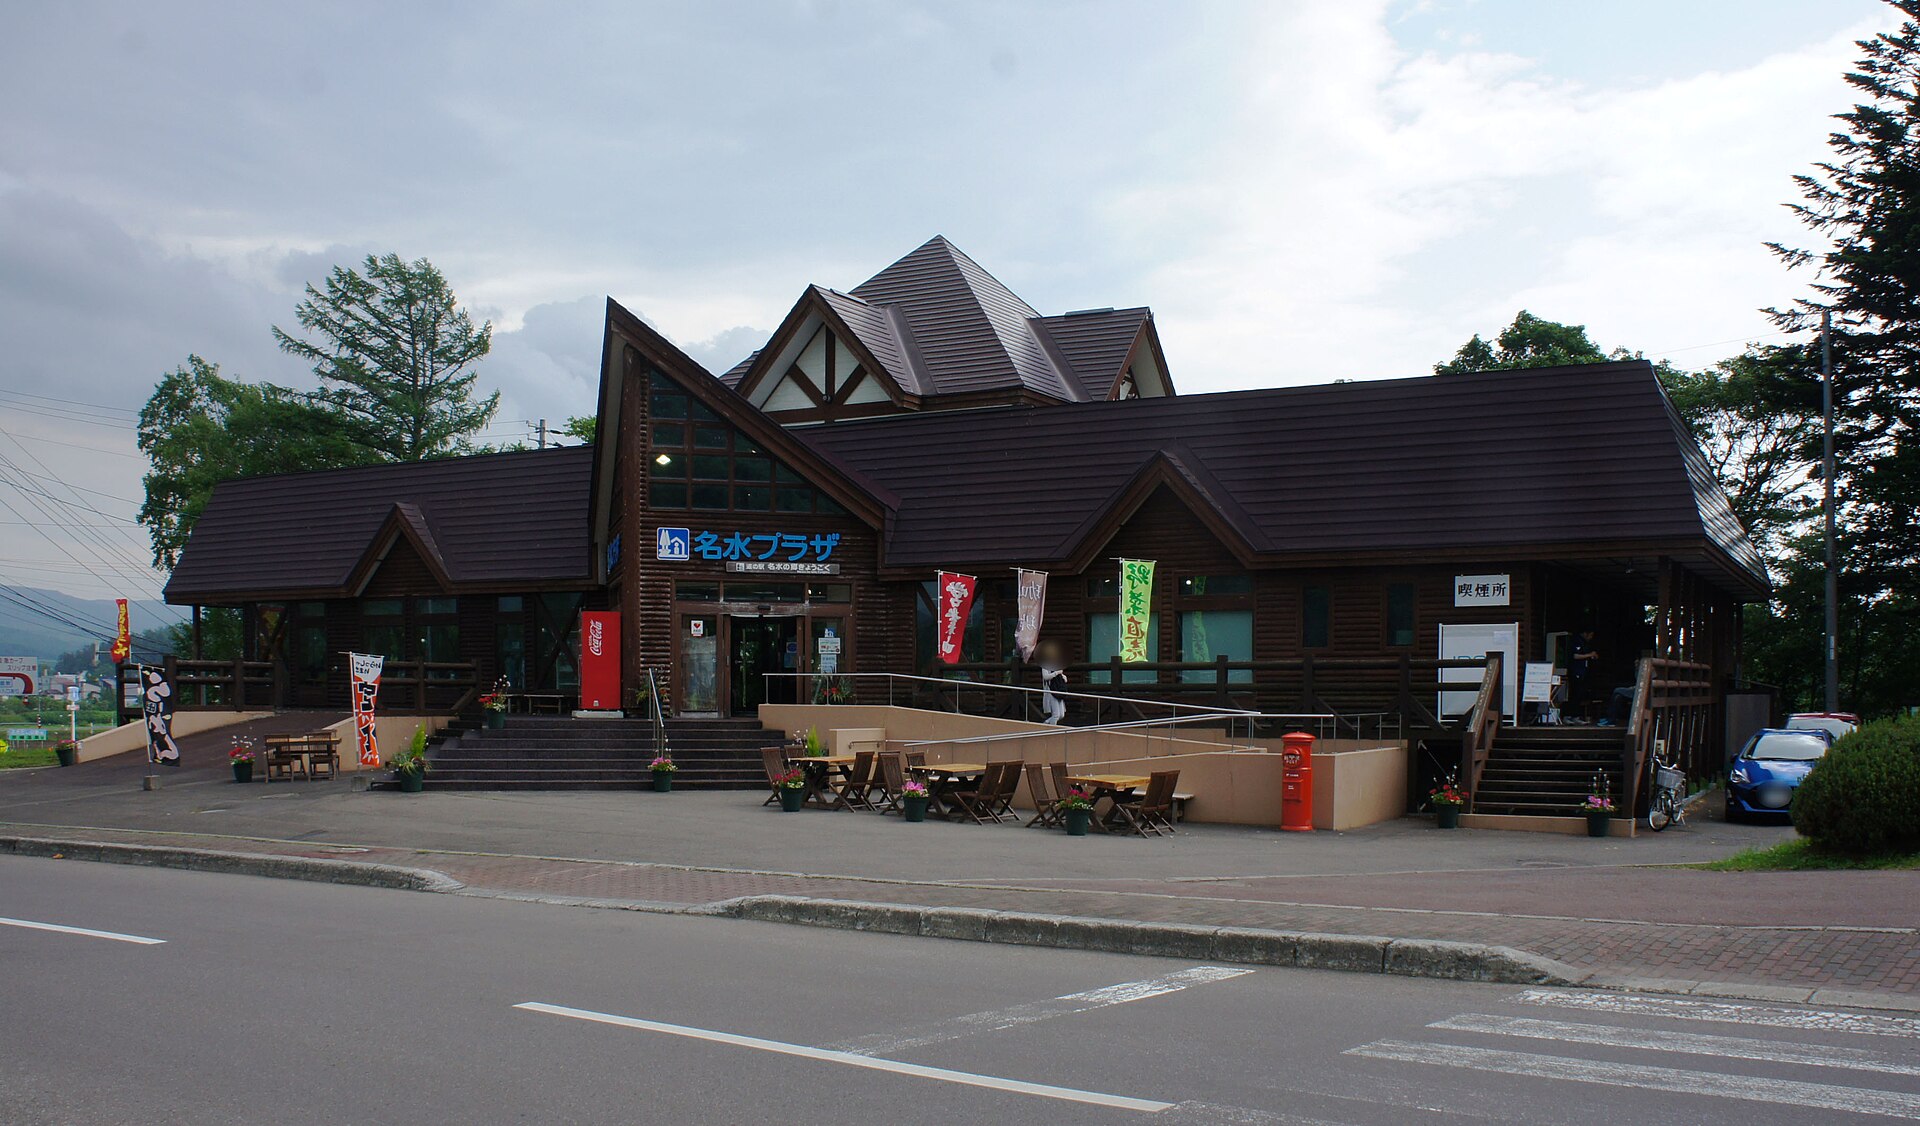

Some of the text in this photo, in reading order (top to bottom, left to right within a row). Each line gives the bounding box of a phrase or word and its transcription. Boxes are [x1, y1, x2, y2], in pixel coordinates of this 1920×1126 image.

[694, 531, 840, 561] 名水プラザ
[1457, 583, 1507, 598] 喫煙所
[589, 619, 604, 656] Coca-Cola
